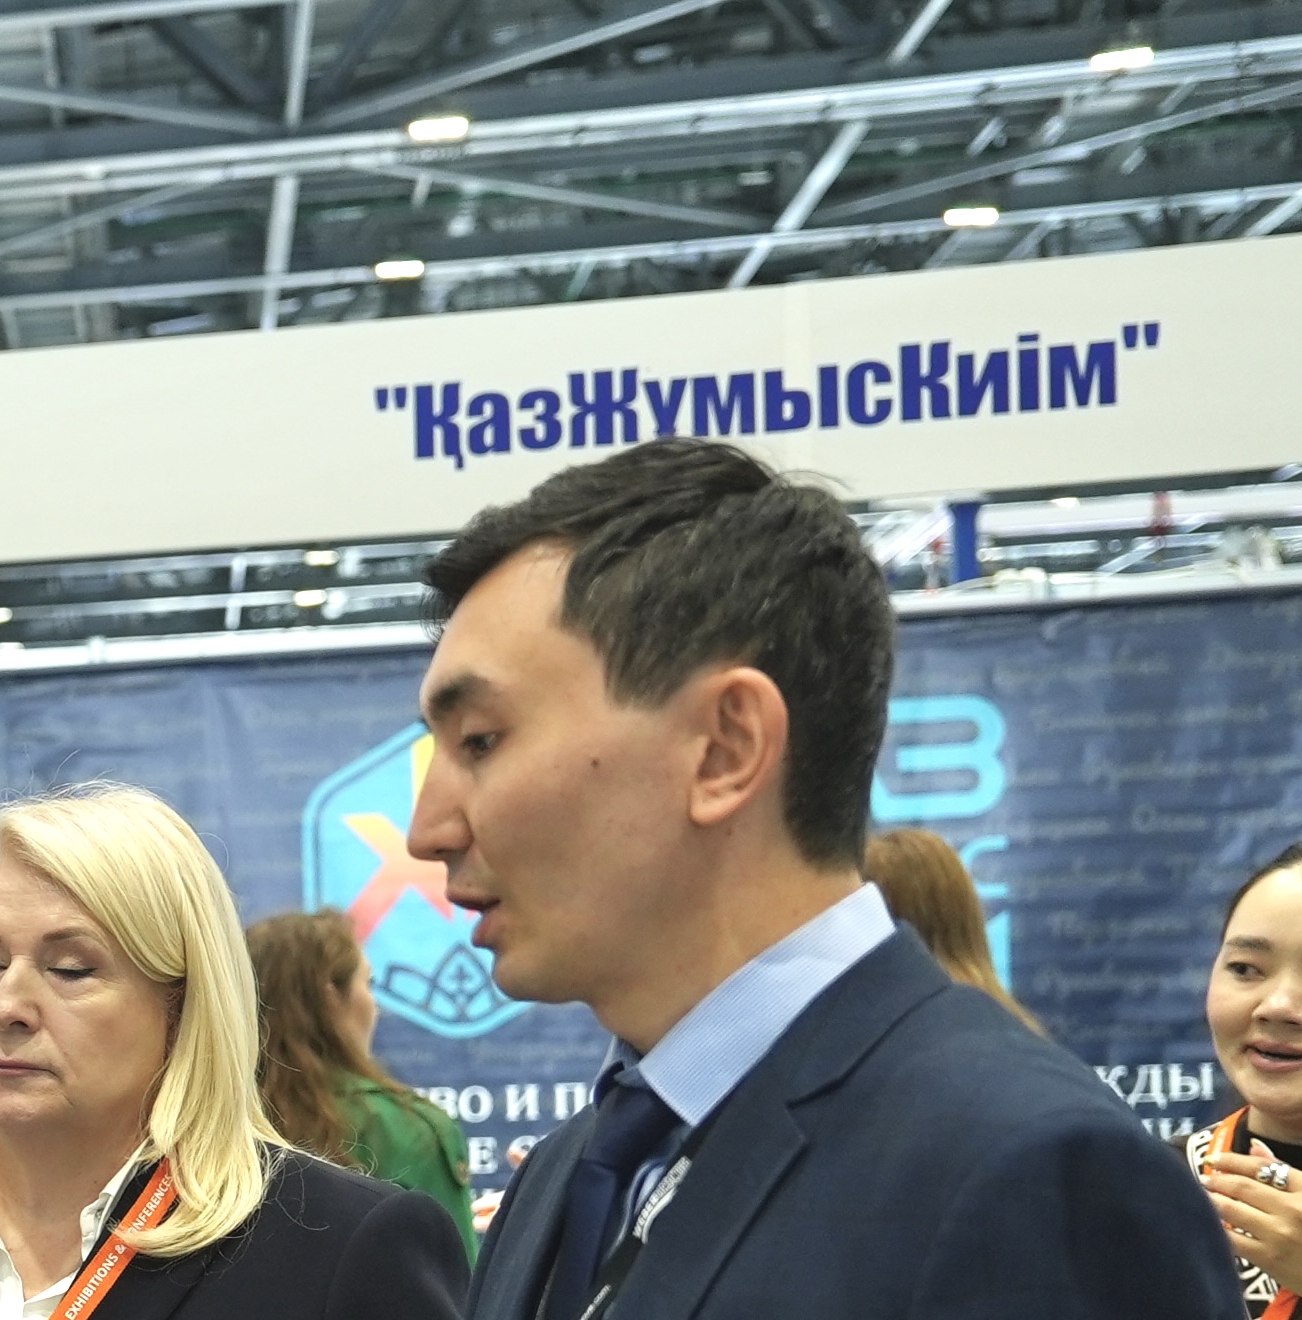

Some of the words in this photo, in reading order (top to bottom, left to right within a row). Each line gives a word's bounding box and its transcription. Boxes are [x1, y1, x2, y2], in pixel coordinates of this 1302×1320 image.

[505, 1083, 541, 1122] И
[64, 1252, 120, 1320] EXHIBITIONS
[114, 1244, 127, 1255] &
